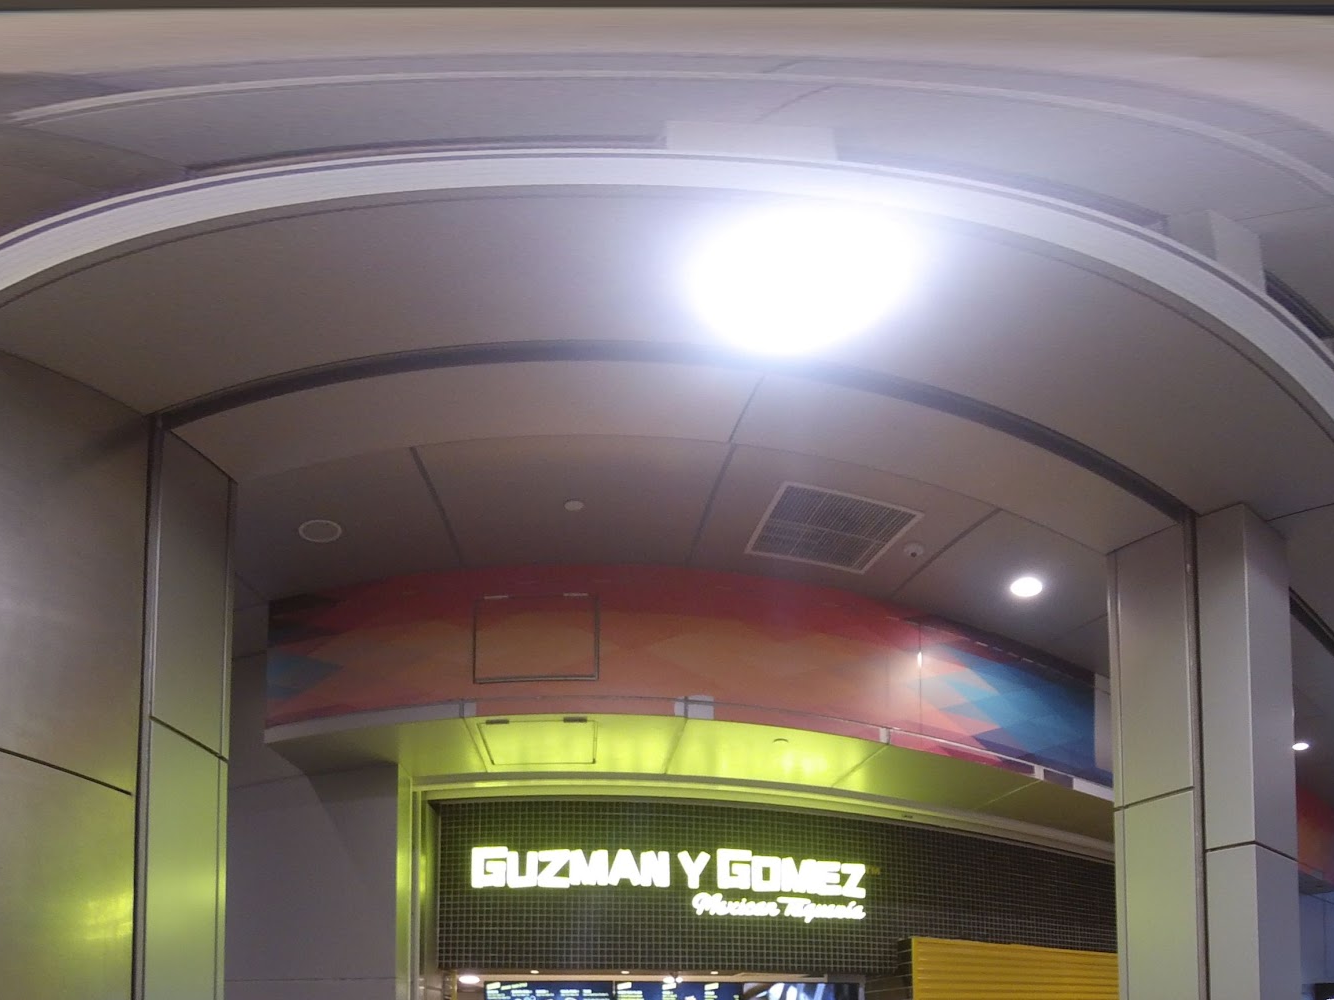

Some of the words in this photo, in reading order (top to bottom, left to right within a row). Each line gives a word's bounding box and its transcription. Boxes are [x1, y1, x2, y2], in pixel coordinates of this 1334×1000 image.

[470, 846, 670, 889] GUZMAN
[677, 850, 711, 889] Y
[716, 847, 866, 899] GOMEZ
